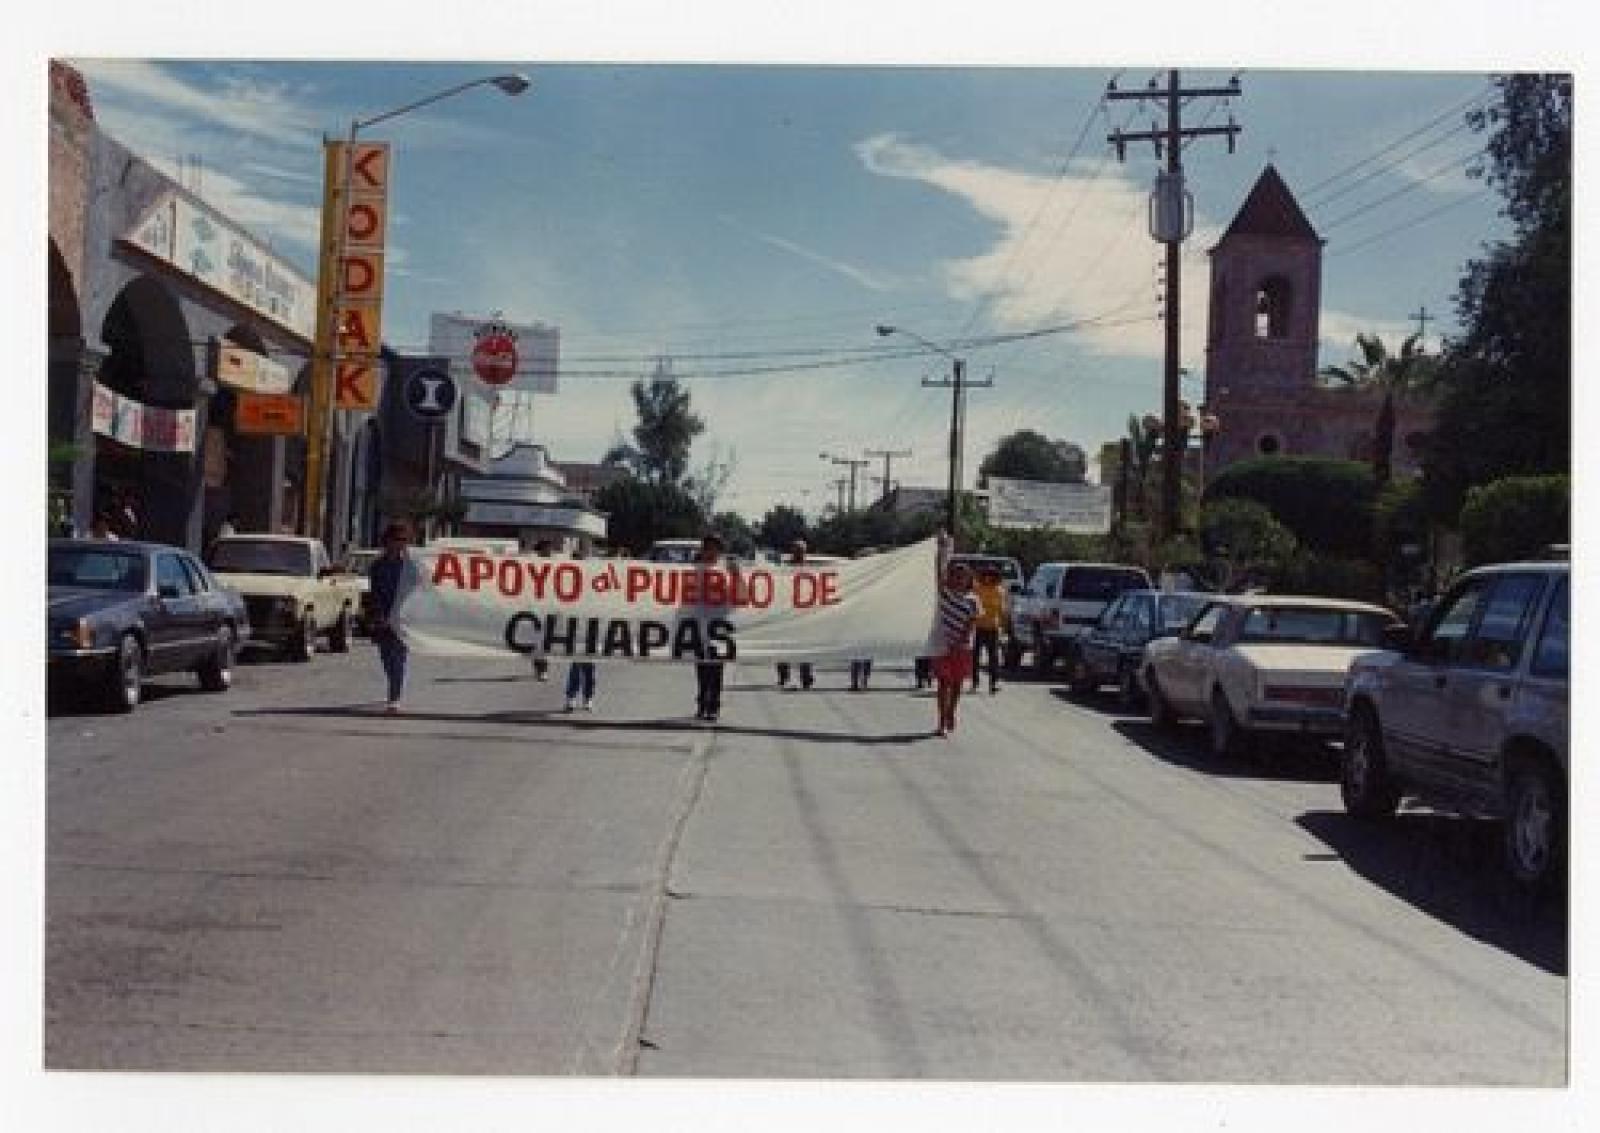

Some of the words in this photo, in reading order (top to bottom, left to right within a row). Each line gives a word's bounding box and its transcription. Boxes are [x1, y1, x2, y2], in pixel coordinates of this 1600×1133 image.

[335, 148, 383, 405] KODAK
[432, 552, 583, 603] APOYO
[592, 562, 621, 592] al
[626, 565, 775, 608] PUEBLO
[792, 571, 842, 608] DE
[504, 610, 737, 661] CHIAPAS
